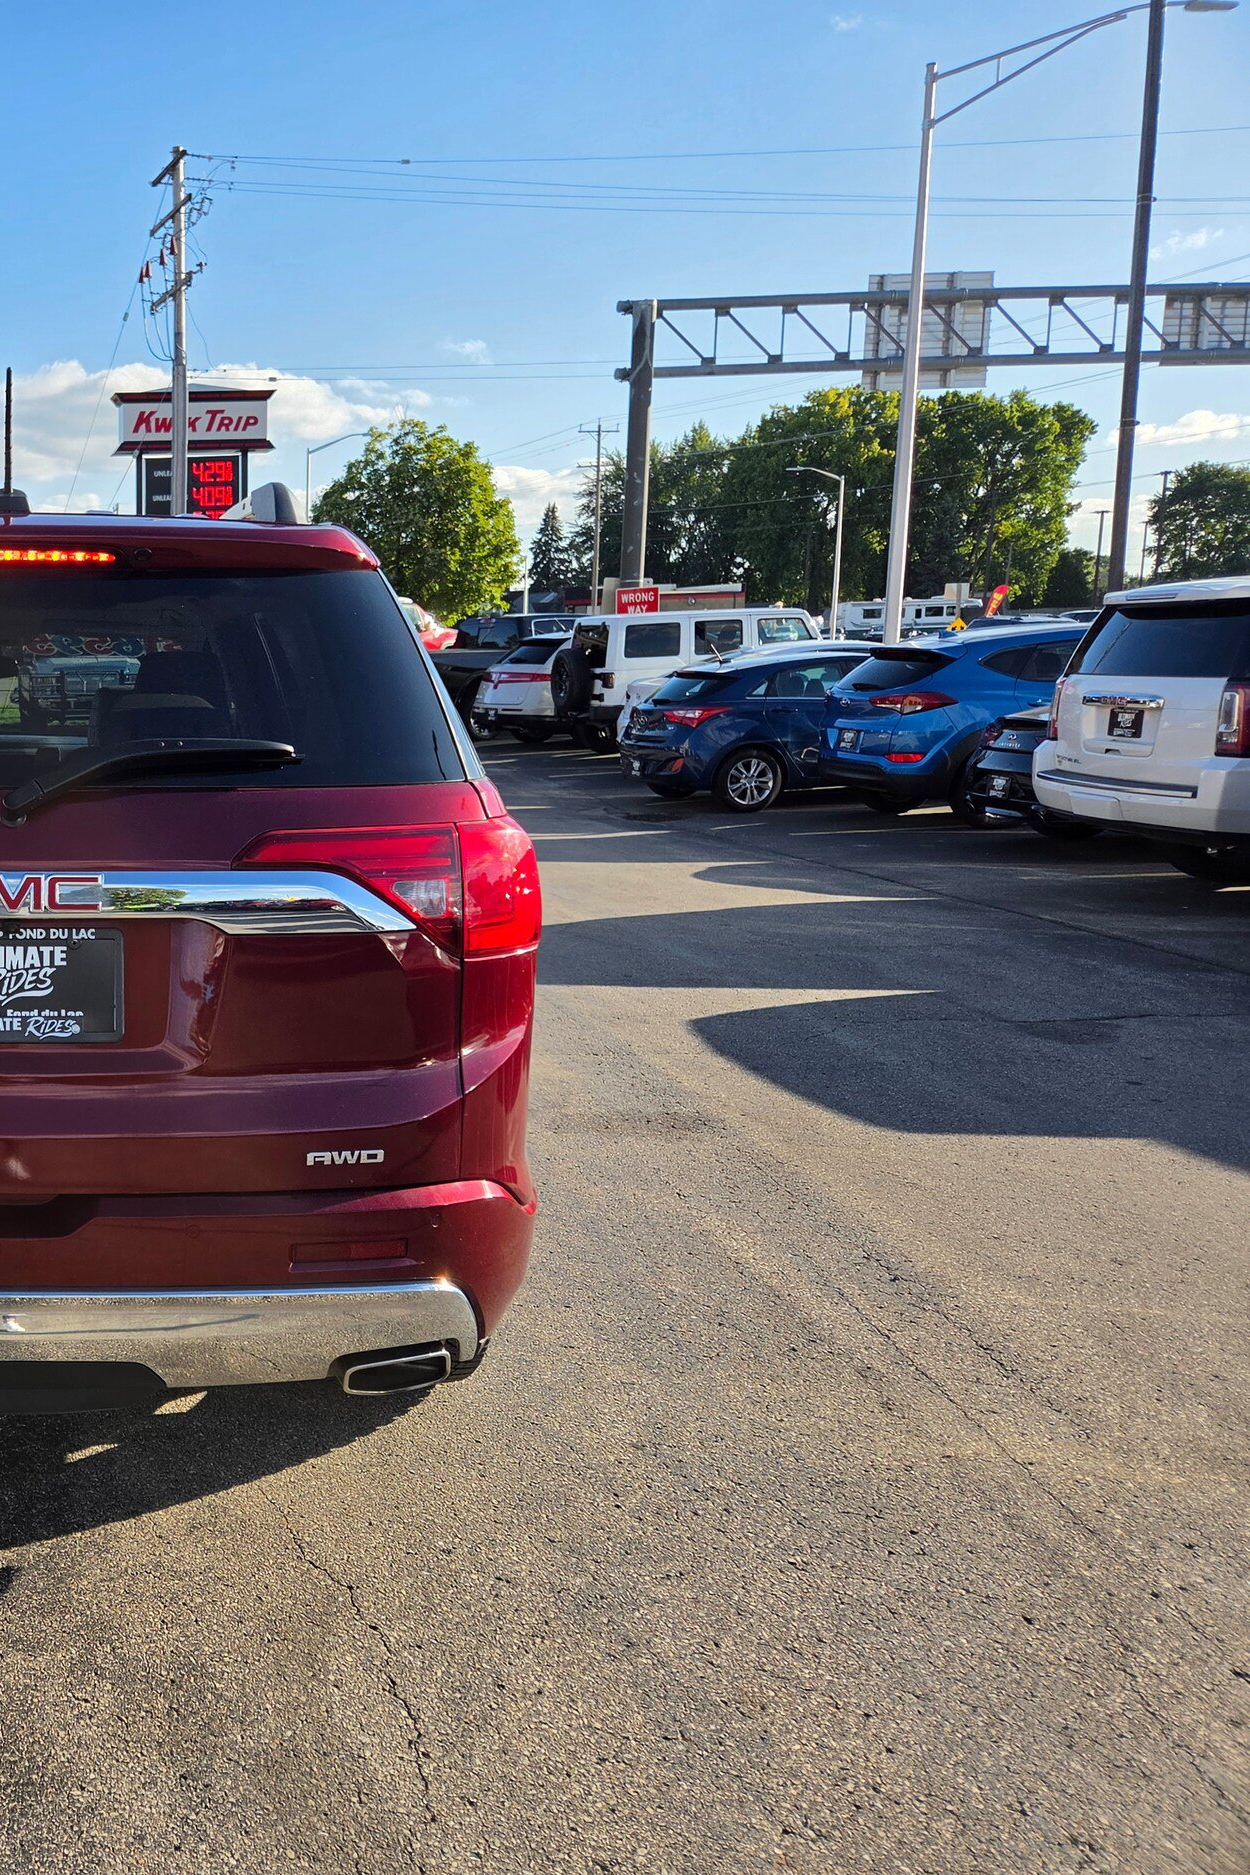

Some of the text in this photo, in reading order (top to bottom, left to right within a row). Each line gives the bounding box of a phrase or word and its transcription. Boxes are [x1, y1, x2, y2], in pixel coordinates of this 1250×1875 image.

[132, 409, 258, 433] KWK TRIP
[621, 592, 654, 603] WRONG
[627, 604, 648, 614] WAY
[50, 929, 68, 939] DU
[72, 929, 96, 939] LAC
[306, 1149, 385, 1166] AWD
